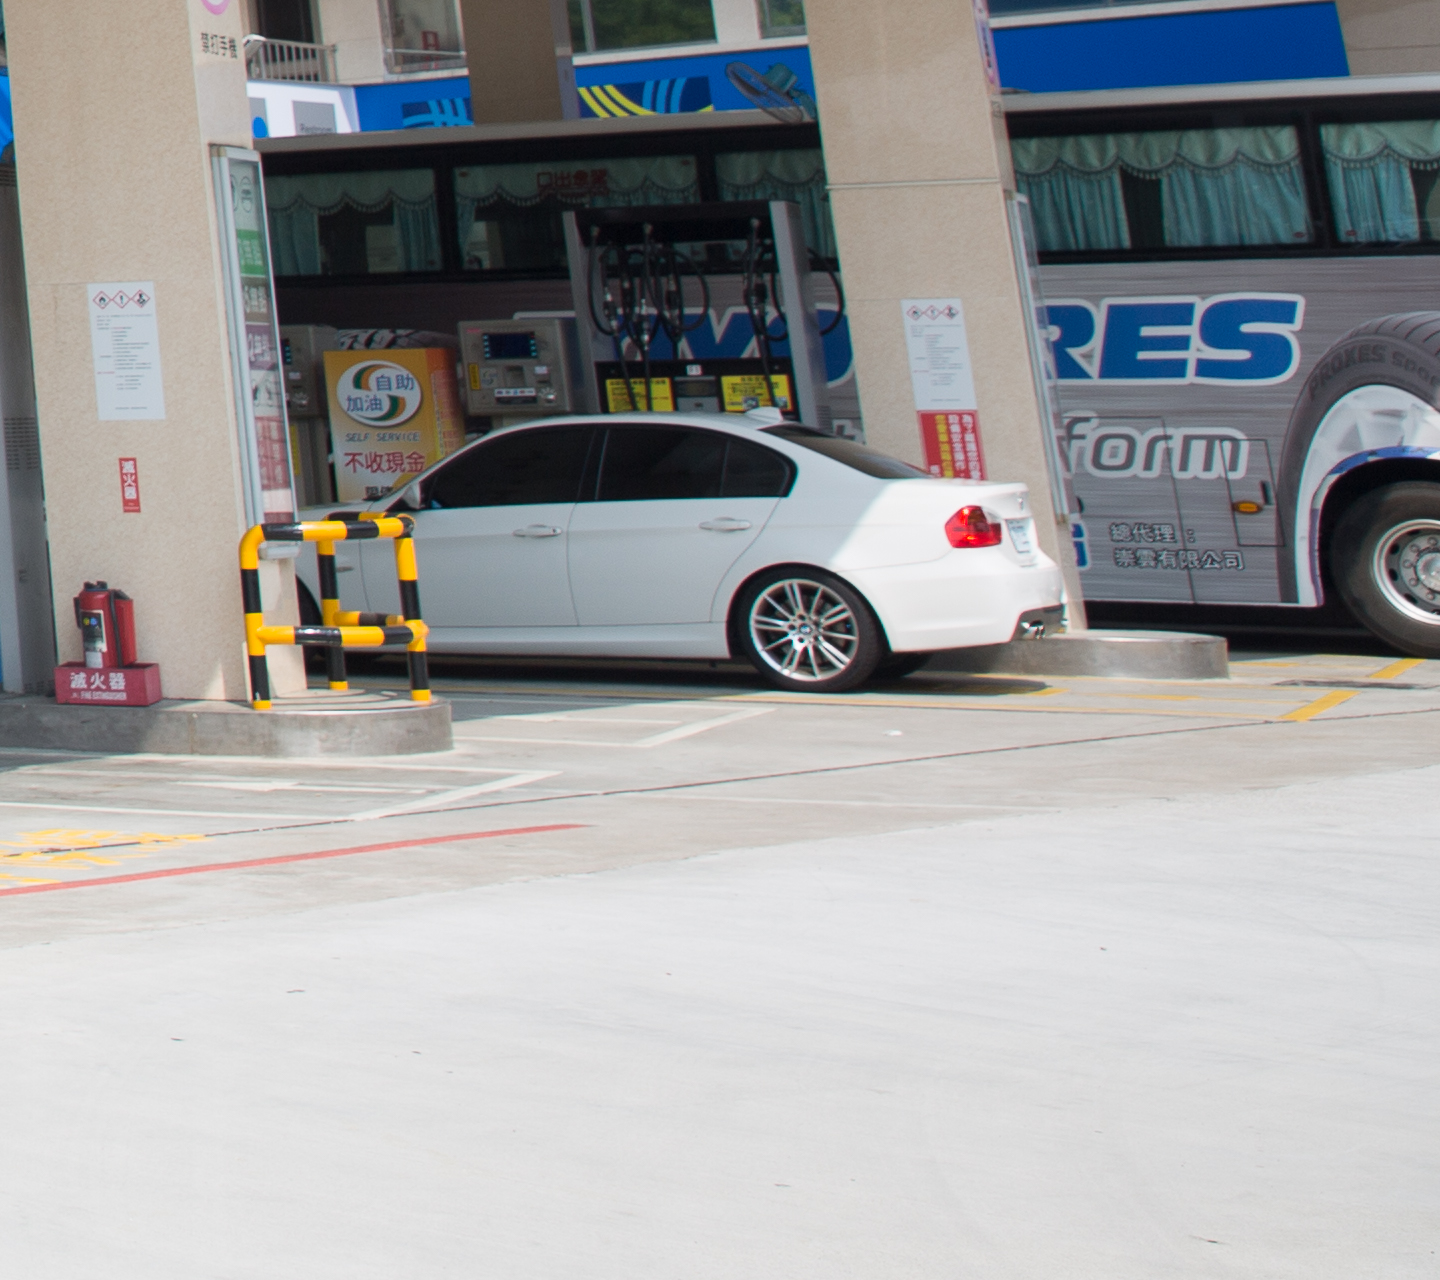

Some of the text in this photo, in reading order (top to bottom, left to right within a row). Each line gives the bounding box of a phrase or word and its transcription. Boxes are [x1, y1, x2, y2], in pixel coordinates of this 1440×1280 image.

[375, 374, 415, 392] 自助
[346, 395, 383, 412] 加油
[345, 431, 421, 442] SELF SERVICE
[344, 451, 425, 473] 不收現金
[121, 460, 137, 499] 滅火器
[70, 671, 126, 690] 滅火器
